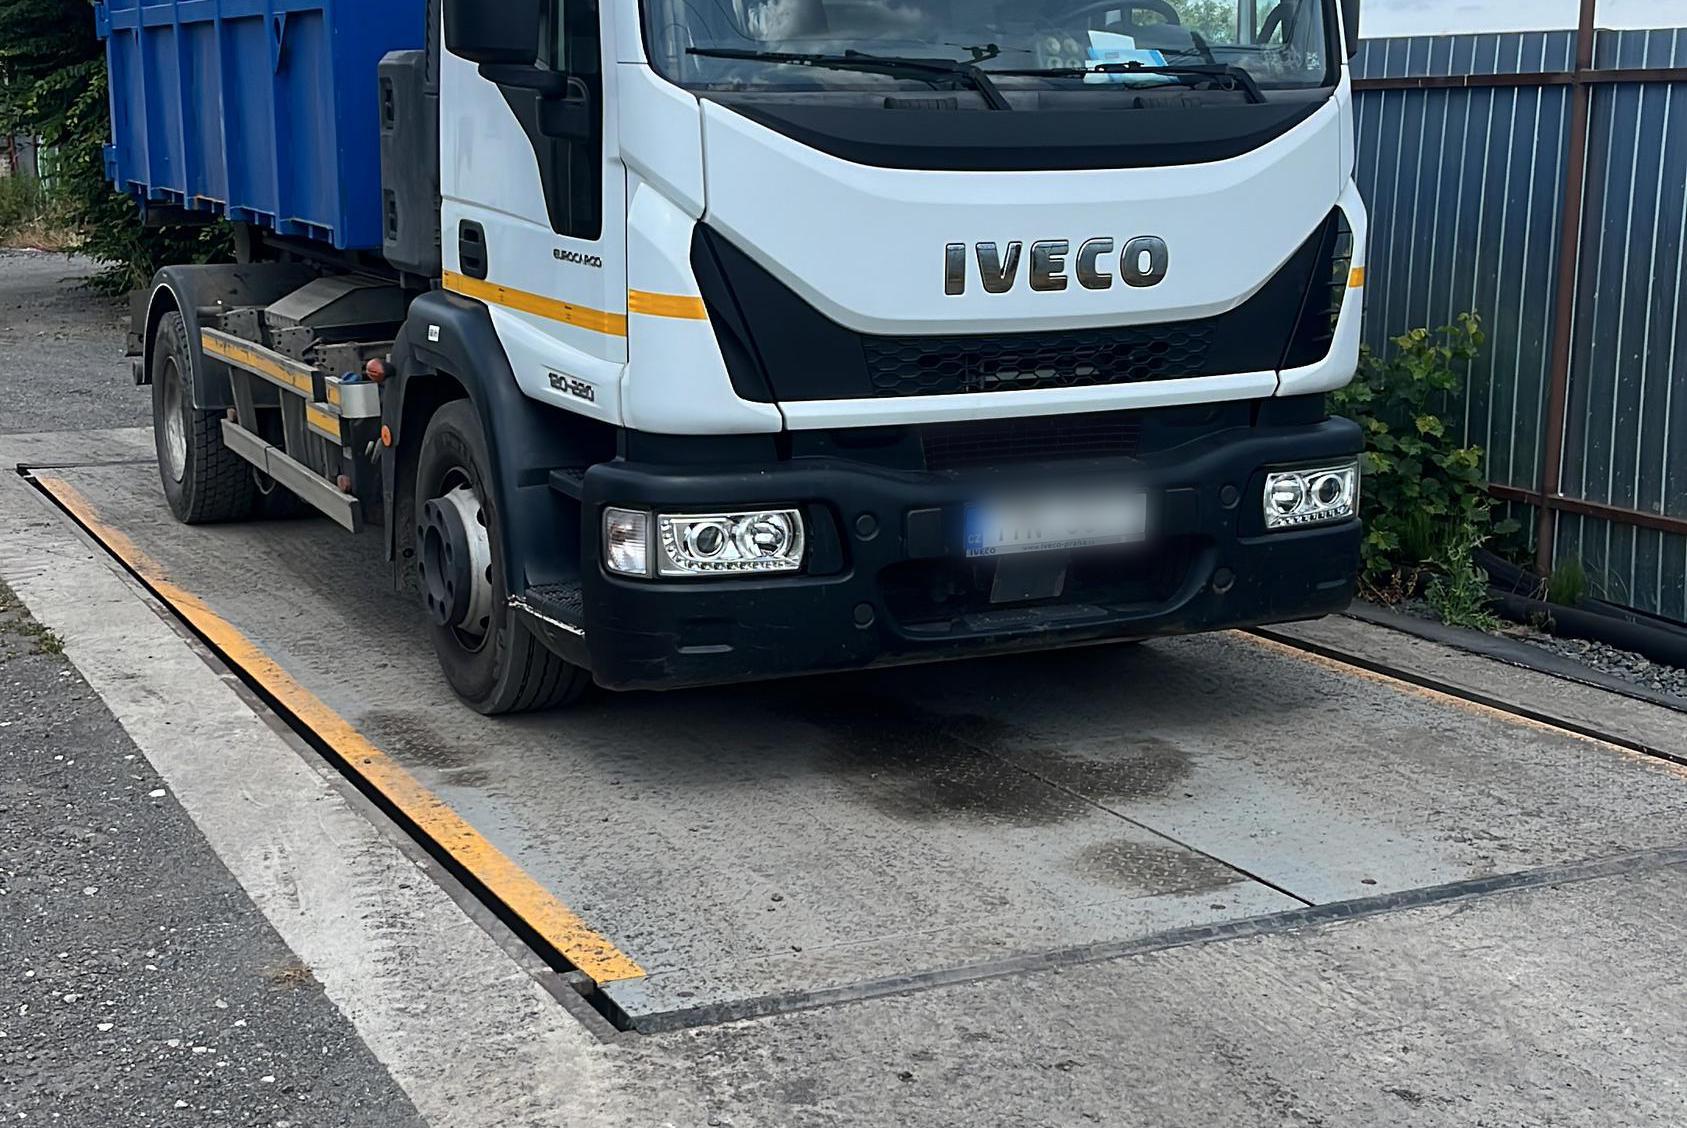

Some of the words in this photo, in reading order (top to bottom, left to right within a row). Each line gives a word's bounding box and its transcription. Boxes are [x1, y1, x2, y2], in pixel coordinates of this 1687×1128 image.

[553, 248, 603, 267] EUROCARGO
[944, 235, 1169, 296] IVECO
[970, 546, 996, 556] IVECO
